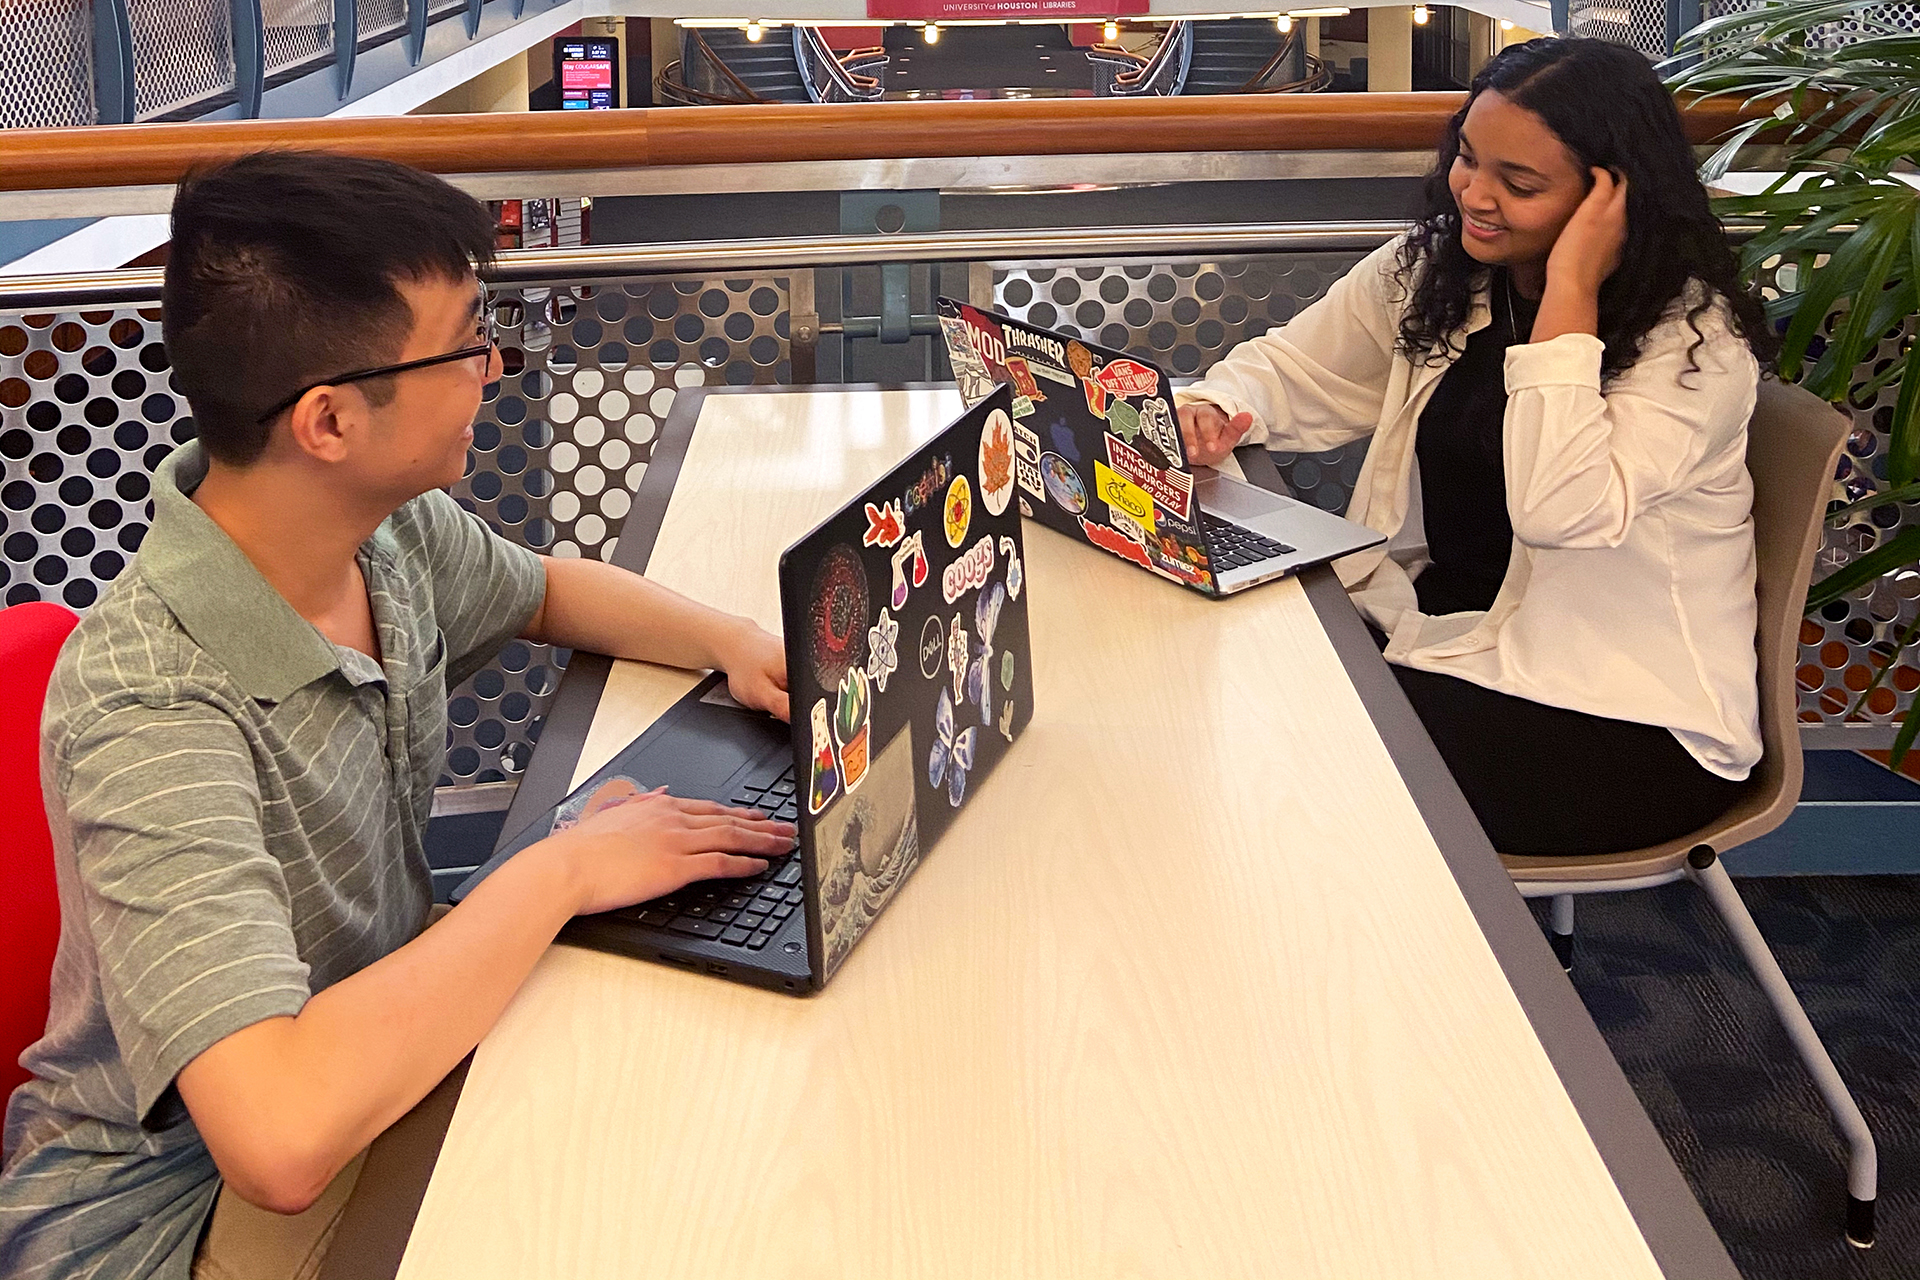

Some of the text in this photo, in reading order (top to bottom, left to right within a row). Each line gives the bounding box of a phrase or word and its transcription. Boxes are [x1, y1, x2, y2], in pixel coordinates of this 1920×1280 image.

[997, 2, 1038, 10] HOUSTON
[1043, 1, 1076, 9] LIBRARIES
[966, 320, 1006, 367] MOD
[1001, 323, 1066, 369] THRASHER
[1110, 362, 1134, 377] VANS
[1119, 375, 1137, 391] THE
[1014, 426, 1037, 444] ATCH
[1156, 416, 1171, 447] YETI
[1018, 459, 1040, 479] HAT
[1112, 441, 1160, 478] IN-N-OUT
[1116, 454, 1181, 502] HAMBURGERS
[1107, 485, 1142, 514] Chaco
[1141, 482, 1182, 510] NO DELAY
[1166, 518, 1197, 535] pepsi
